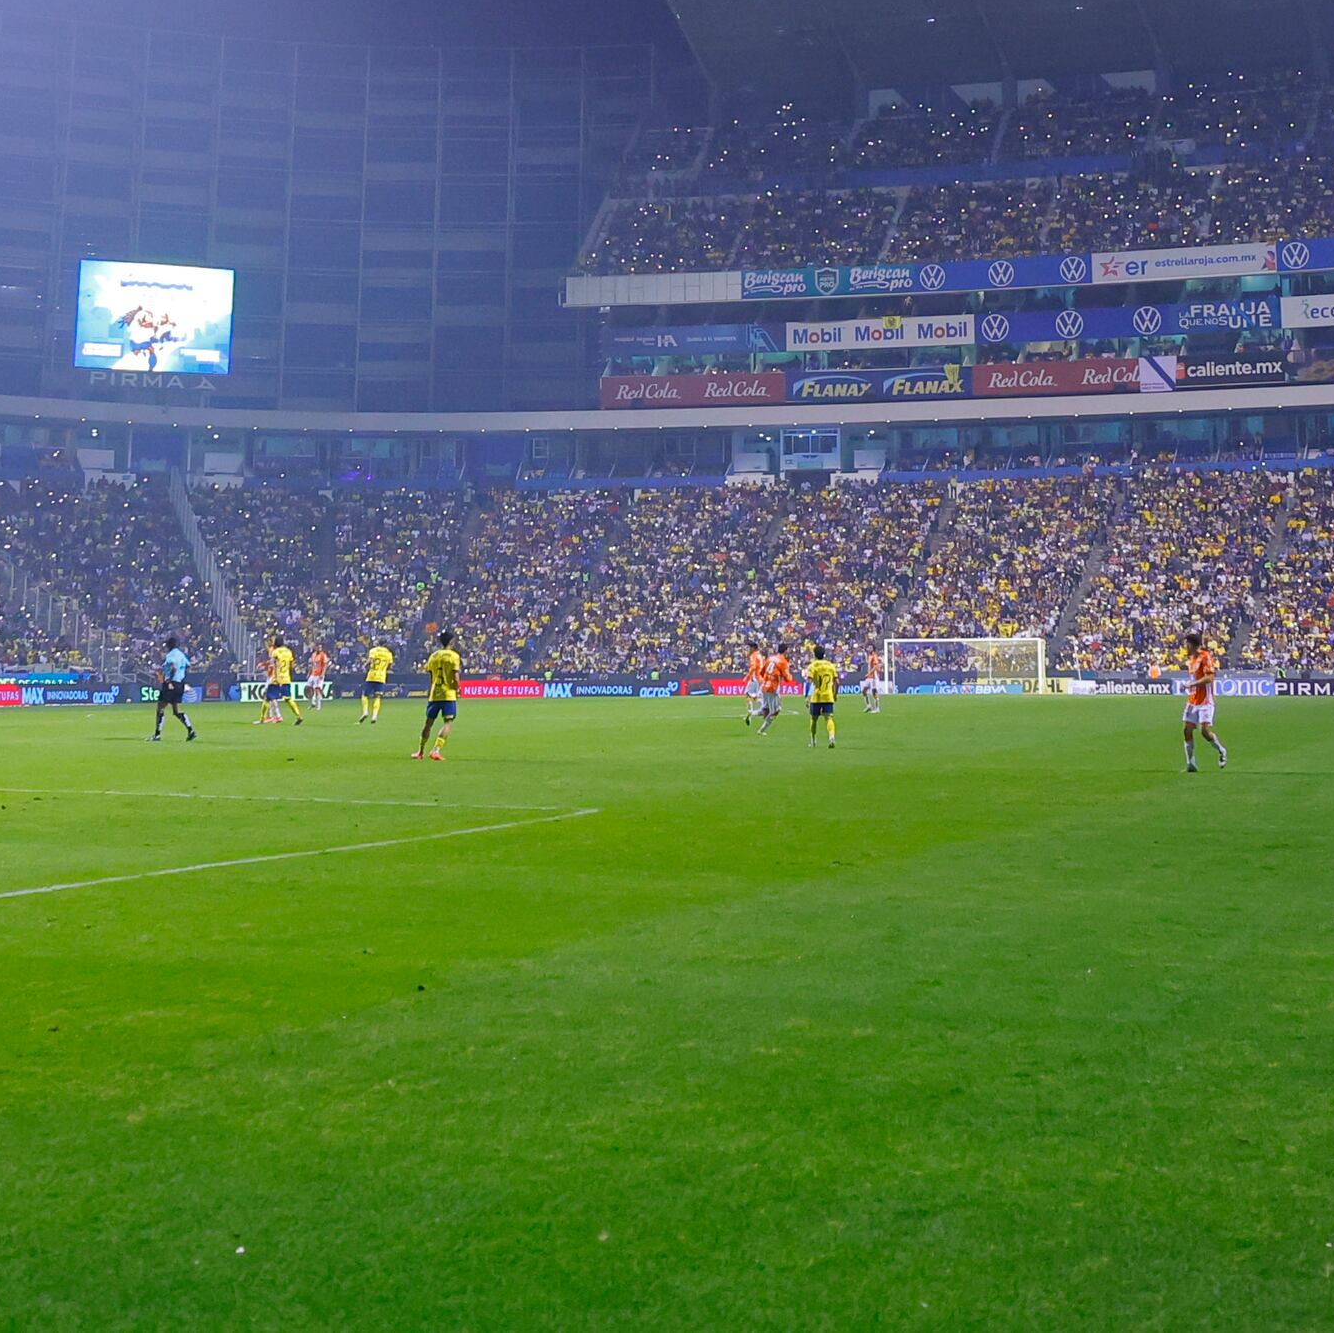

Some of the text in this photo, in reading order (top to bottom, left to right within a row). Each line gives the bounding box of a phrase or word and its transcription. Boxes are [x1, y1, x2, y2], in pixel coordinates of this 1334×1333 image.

[793, 321, 967, 344] Mobil Mobil Mobil
[1186, 361, 1283, 379] caliente.mx
[89, 371, 186, 389] PIRMA
[21, 687, 45, 705] MAX
[92, 691, 115, 703] acros
[464, 682, 671, 698] NUEVAS ESTUFAS MAX INNOVADORAS acros
[975, 685, 1007, 694] BBVA
